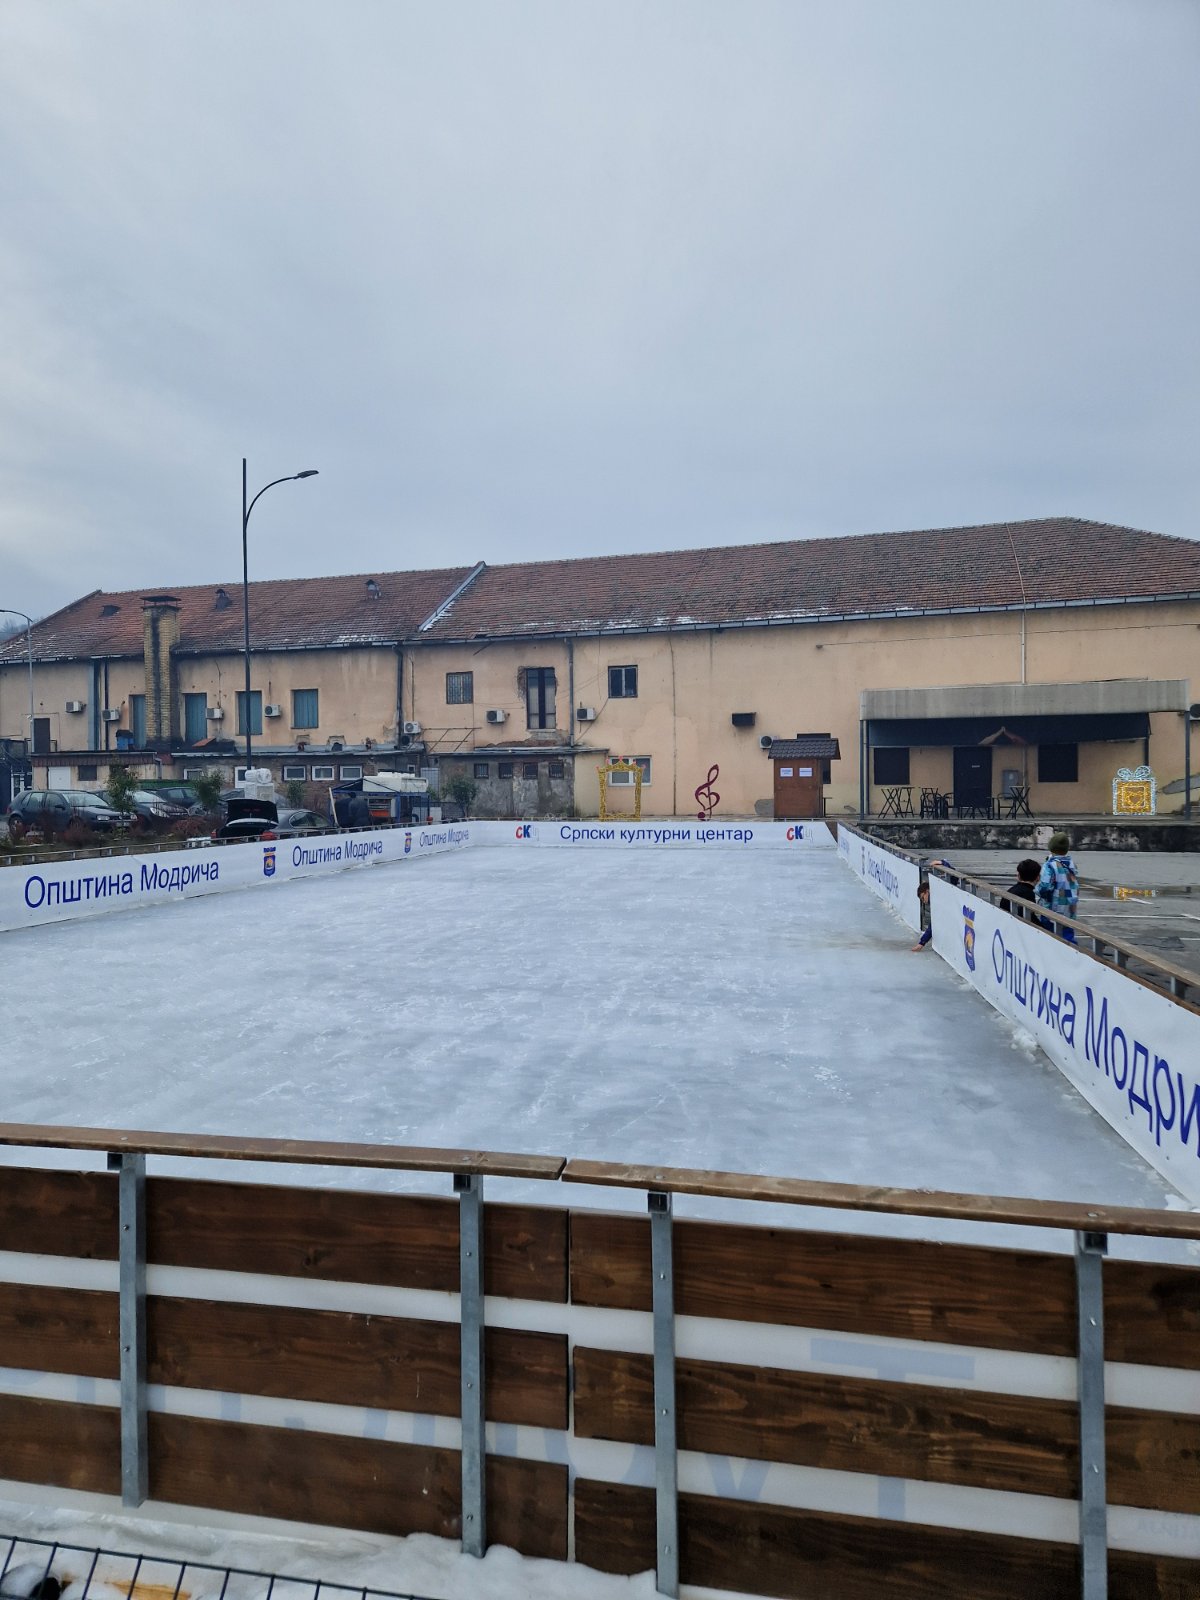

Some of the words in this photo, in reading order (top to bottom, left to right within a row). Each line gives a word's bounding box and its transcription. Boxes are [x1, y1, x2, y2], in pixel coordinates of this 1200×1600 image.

[419, 830, 447, 848] Општина
[447, 827, 470, 845] Модрича
[560, 825, 615, 842] Српски
[620, 829, 691, 842] културни
[696, 829, 754, 842] центар
[292, 845, 342, 867] Општина
[344, 840, 383, 861] Модрича
[25, 872, 133, 908] Општина
[140, 861, 219, 892] Модрича
[992, 928, 1076, 1049] Општина
